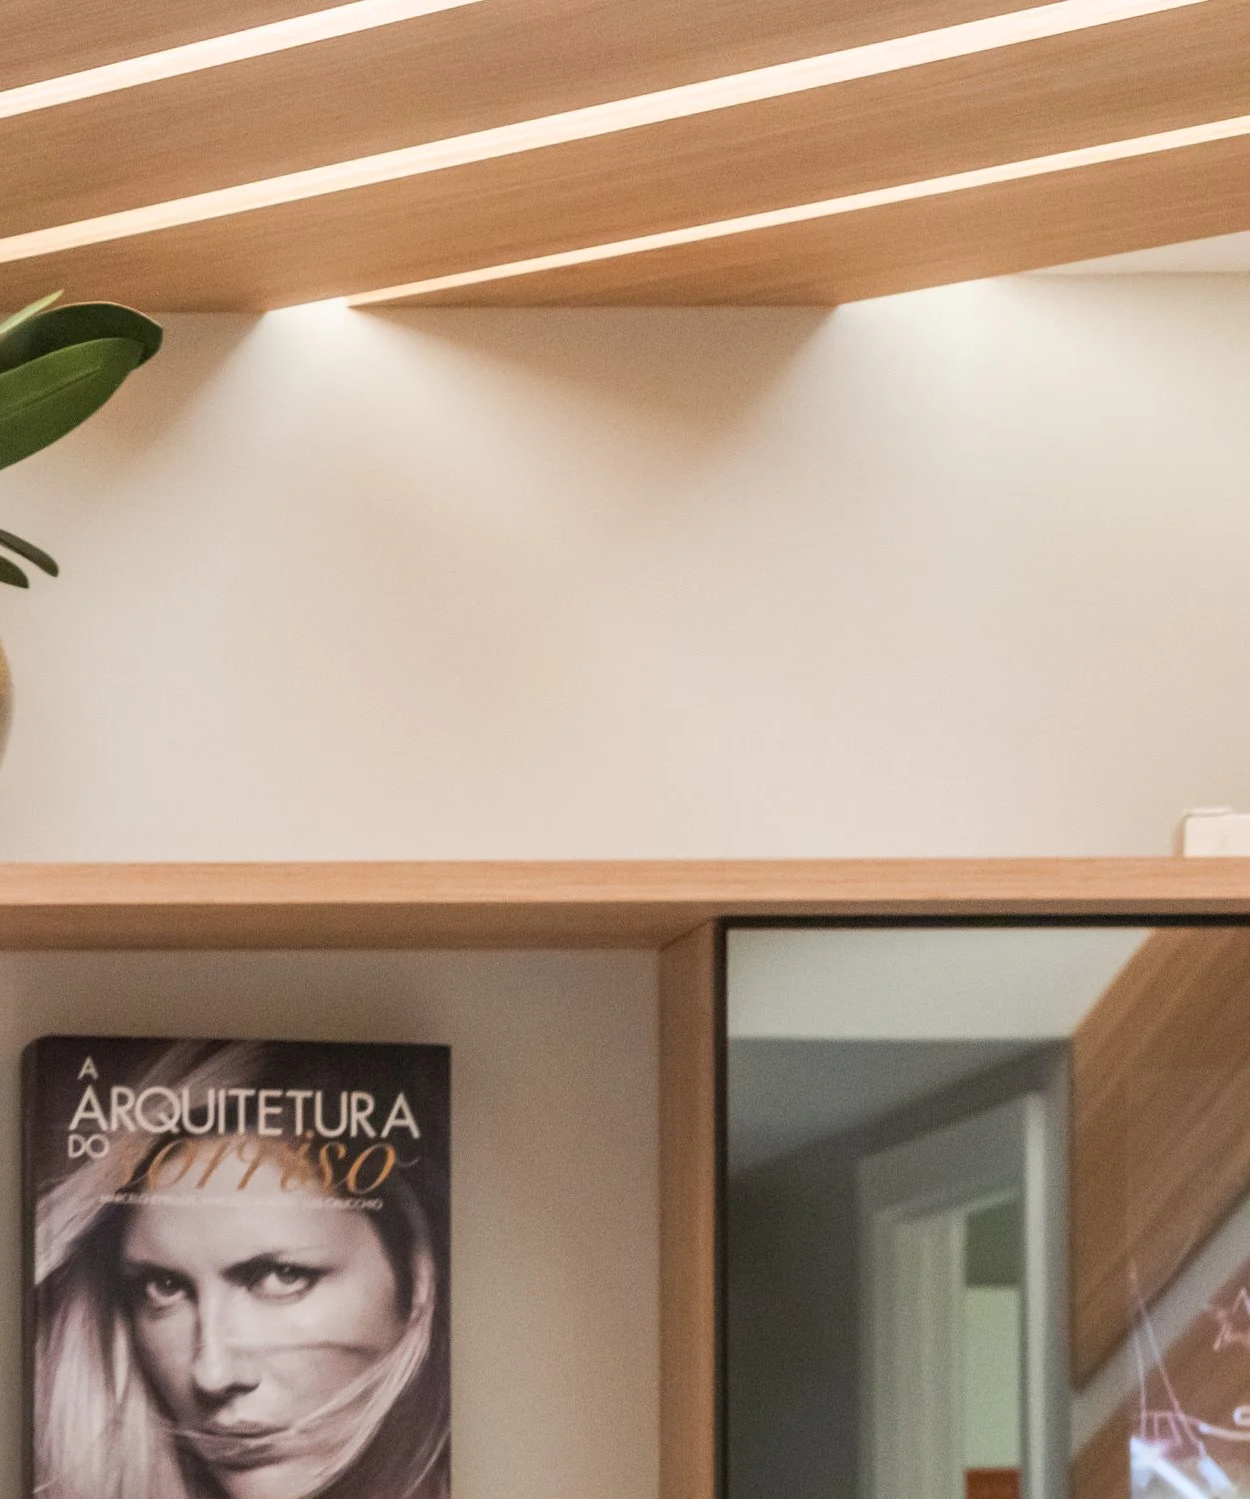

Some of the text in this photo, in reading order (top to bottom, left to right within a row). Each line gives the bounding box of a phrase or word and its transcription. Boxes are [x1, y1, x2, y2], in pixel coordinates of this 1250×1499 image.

[78, 1056, 99, 1081] A
[68, 1085, 421, 1140] ARQUITETURA
[68, 1133, 110, 1159] DO
